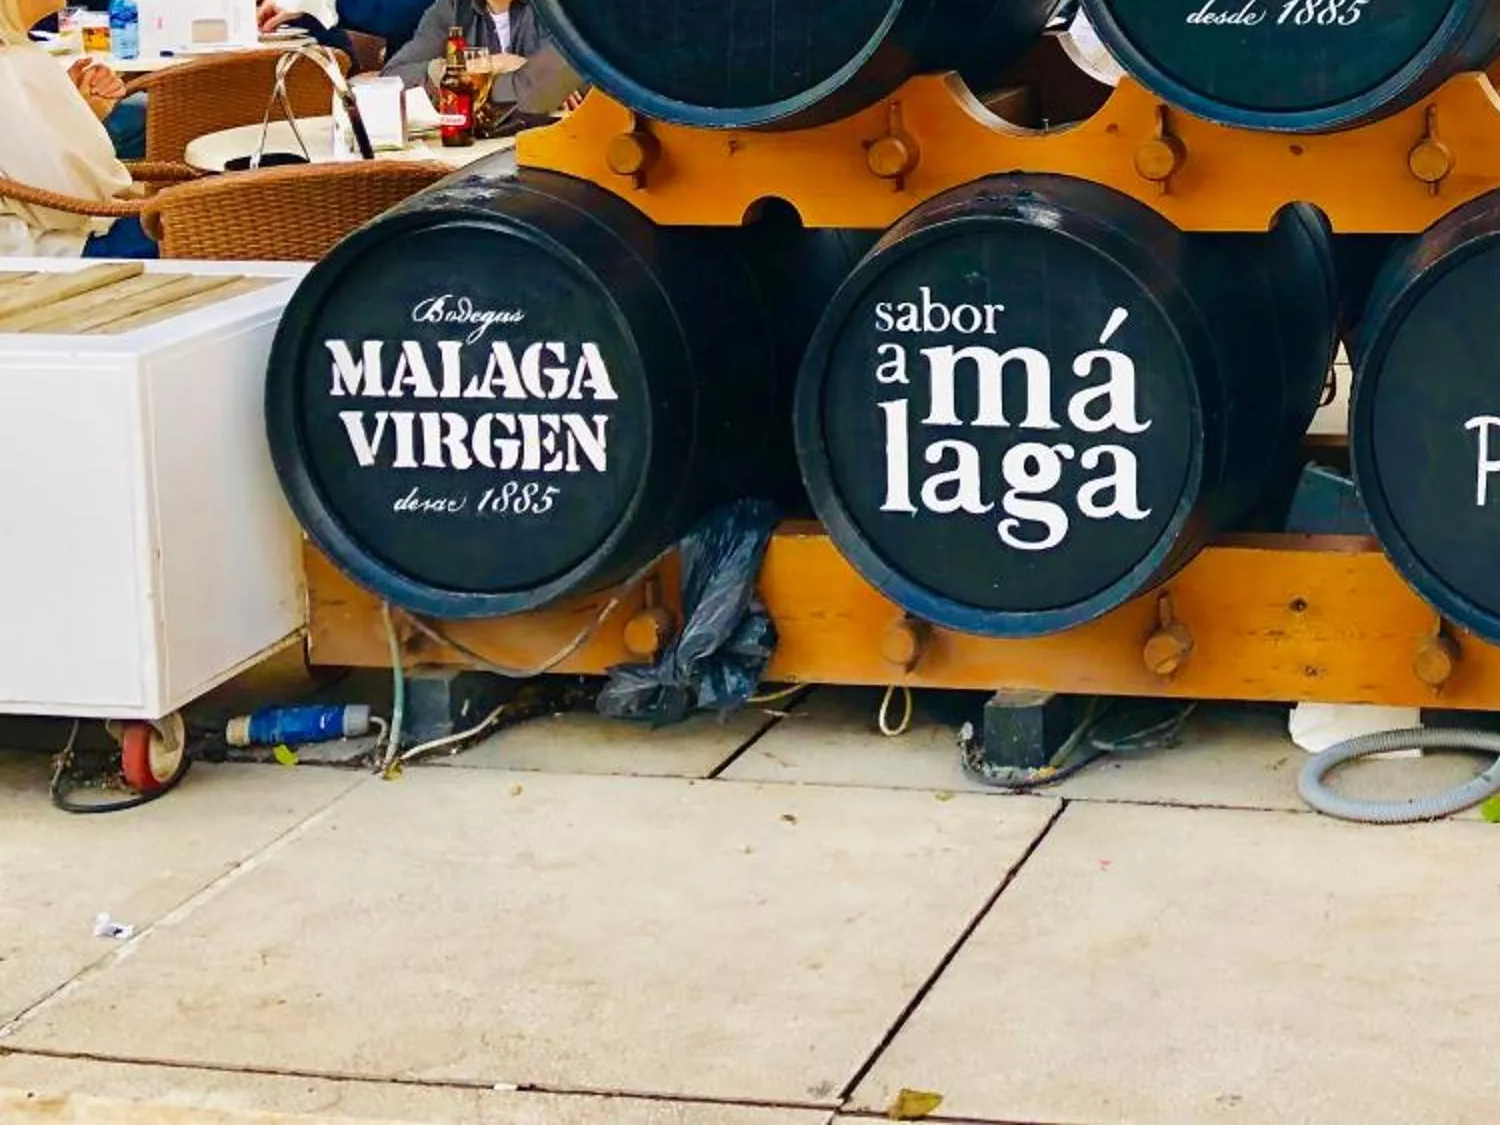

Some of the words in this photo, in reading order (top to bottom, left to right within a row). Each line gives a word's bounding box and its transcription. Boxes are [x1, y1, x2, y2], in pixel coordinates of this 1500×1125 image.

[412, 294, 525, 345] Bodegas
[875, 286, 1005, 334] sabor
[325, 339, 619, 400] MALAGA
[875, 343, 910, 384] a
[920, 307, 1152, 434] má
[339, 410, 609, 473] VIRGEN
[477, 481, 560, 514] 1885
[877, 398, 1152, 550] laga
